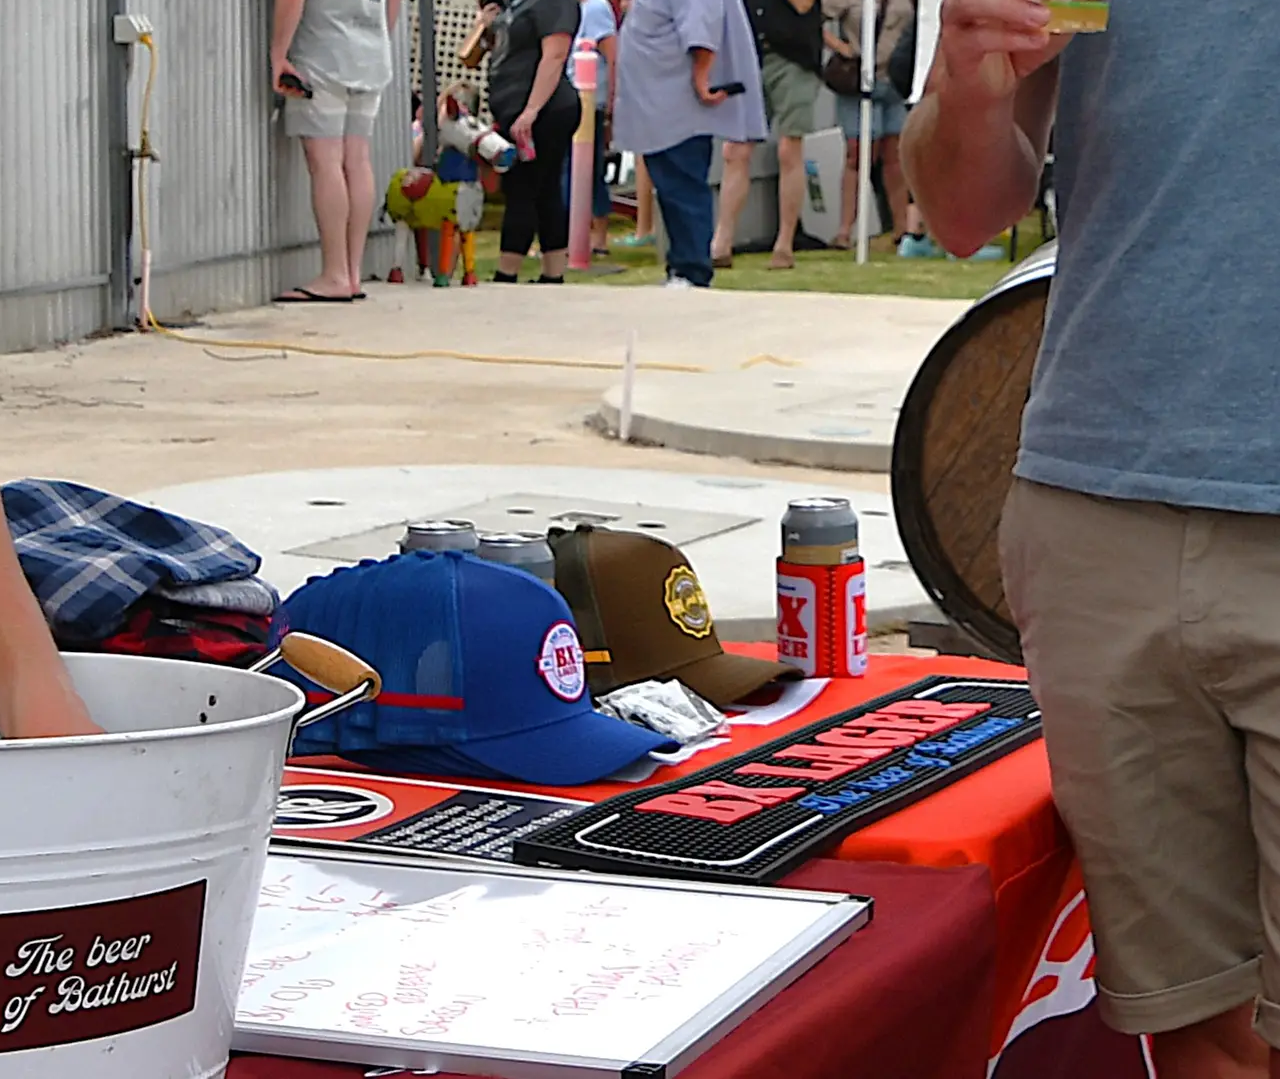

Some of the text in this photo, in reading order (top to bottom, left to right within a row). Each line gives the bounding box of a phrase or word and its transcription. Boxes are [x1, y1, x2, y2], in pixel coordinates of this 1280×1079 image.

[554, 645, 577, 668] BX
[633, 699, 992, 825] BX LAGER
[797, 791, 872, 815] The
[846, 766, 915, 792] beer
[903, 750, 951, 768] of
[5, 931, 152, 979] The beer
[0, 960, 177, 1034] of Bathurst
